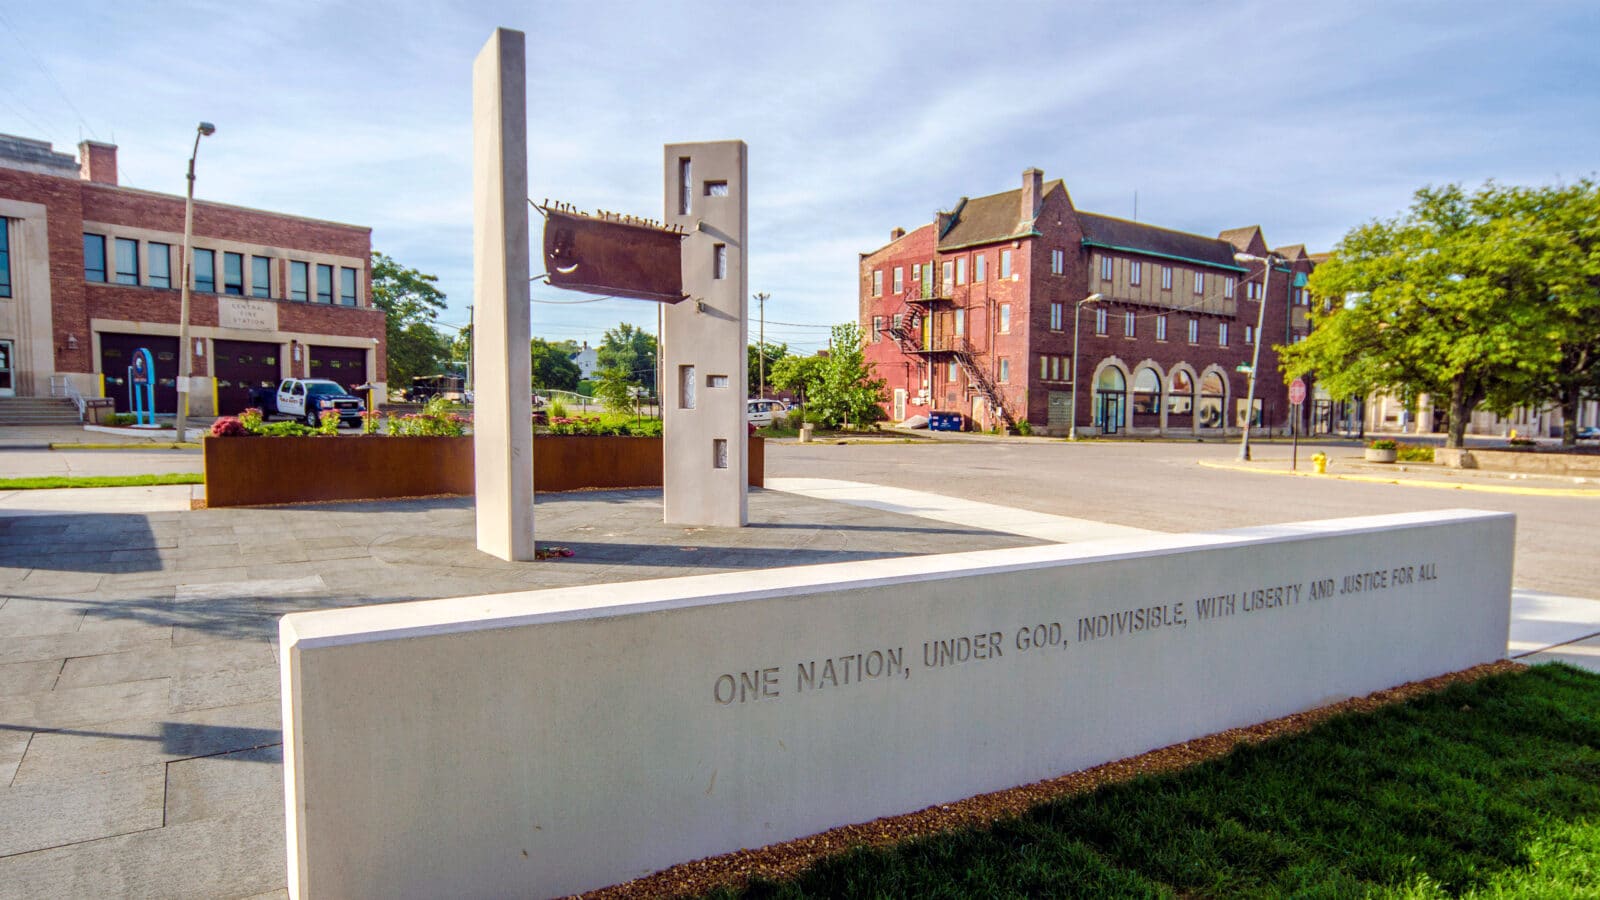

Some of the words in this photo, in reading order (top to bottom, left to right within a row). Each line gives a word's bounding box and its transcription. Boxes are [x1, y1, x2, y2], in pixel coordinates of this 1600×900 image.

[231, 303, 264, 311] CENTRAL
[232, 317, 265, 325] STATION
[713, 667, 780, 705] ONE
[797, 648, 909, 692] NATION,
[923, 631, 1003, 668] UNDER
[1016, 621, 1068, 651] GOD,
[1078, 603, 1187, 642] INDIVISIBLE,
[1196, 593, 1235, 620] WITH
[1242, 583, 1302, 611] LIBERTY
[1309, 578, 1335, 600] AND
[1340, 570, 1387, 595] JUSTICE
[1392, 566, 1414, 586] FOR
[1418, 563, 1438, 580] ALL
